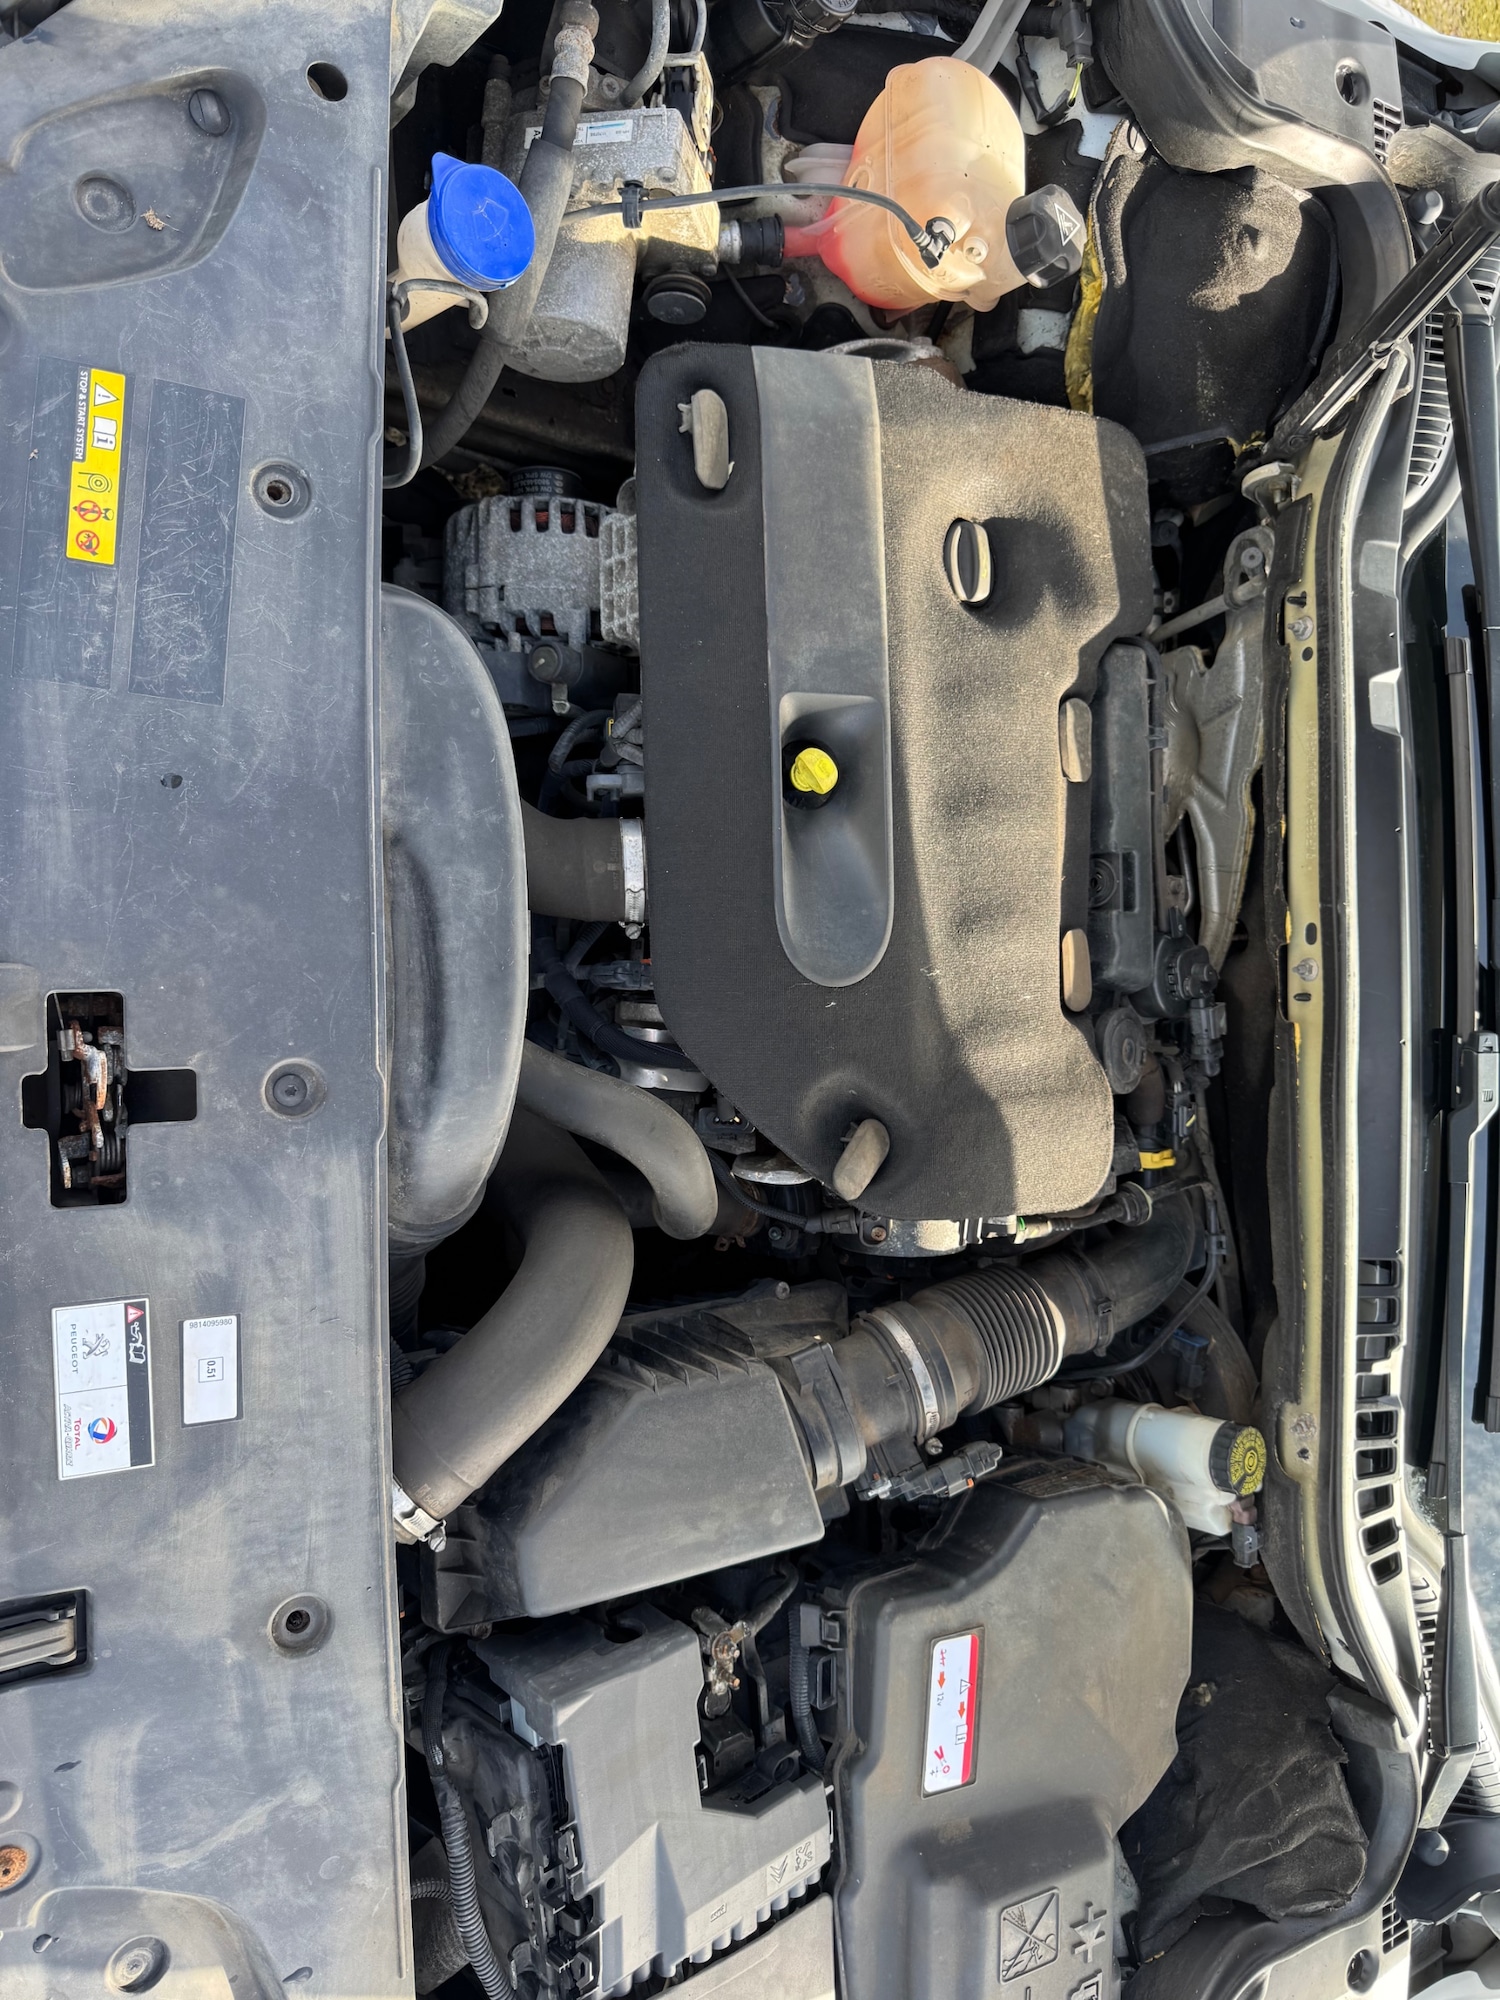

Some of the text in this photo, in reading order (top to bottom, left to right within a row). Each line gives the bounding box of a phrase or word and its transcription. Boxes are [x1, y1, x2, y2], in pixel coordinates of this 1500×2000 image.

[79, 371, 88, 393] STOP
[77, 401, 86, 427] START
[75, 427, 84, 460] SYSTEM
[189, 1318, 233, 1329] 9814095980
[70, 1323, 79, 1374] PEUGEOT
[206, 1360, 216, 1379] 0.51
[73, 1418, 82, 1450] TOTAL
